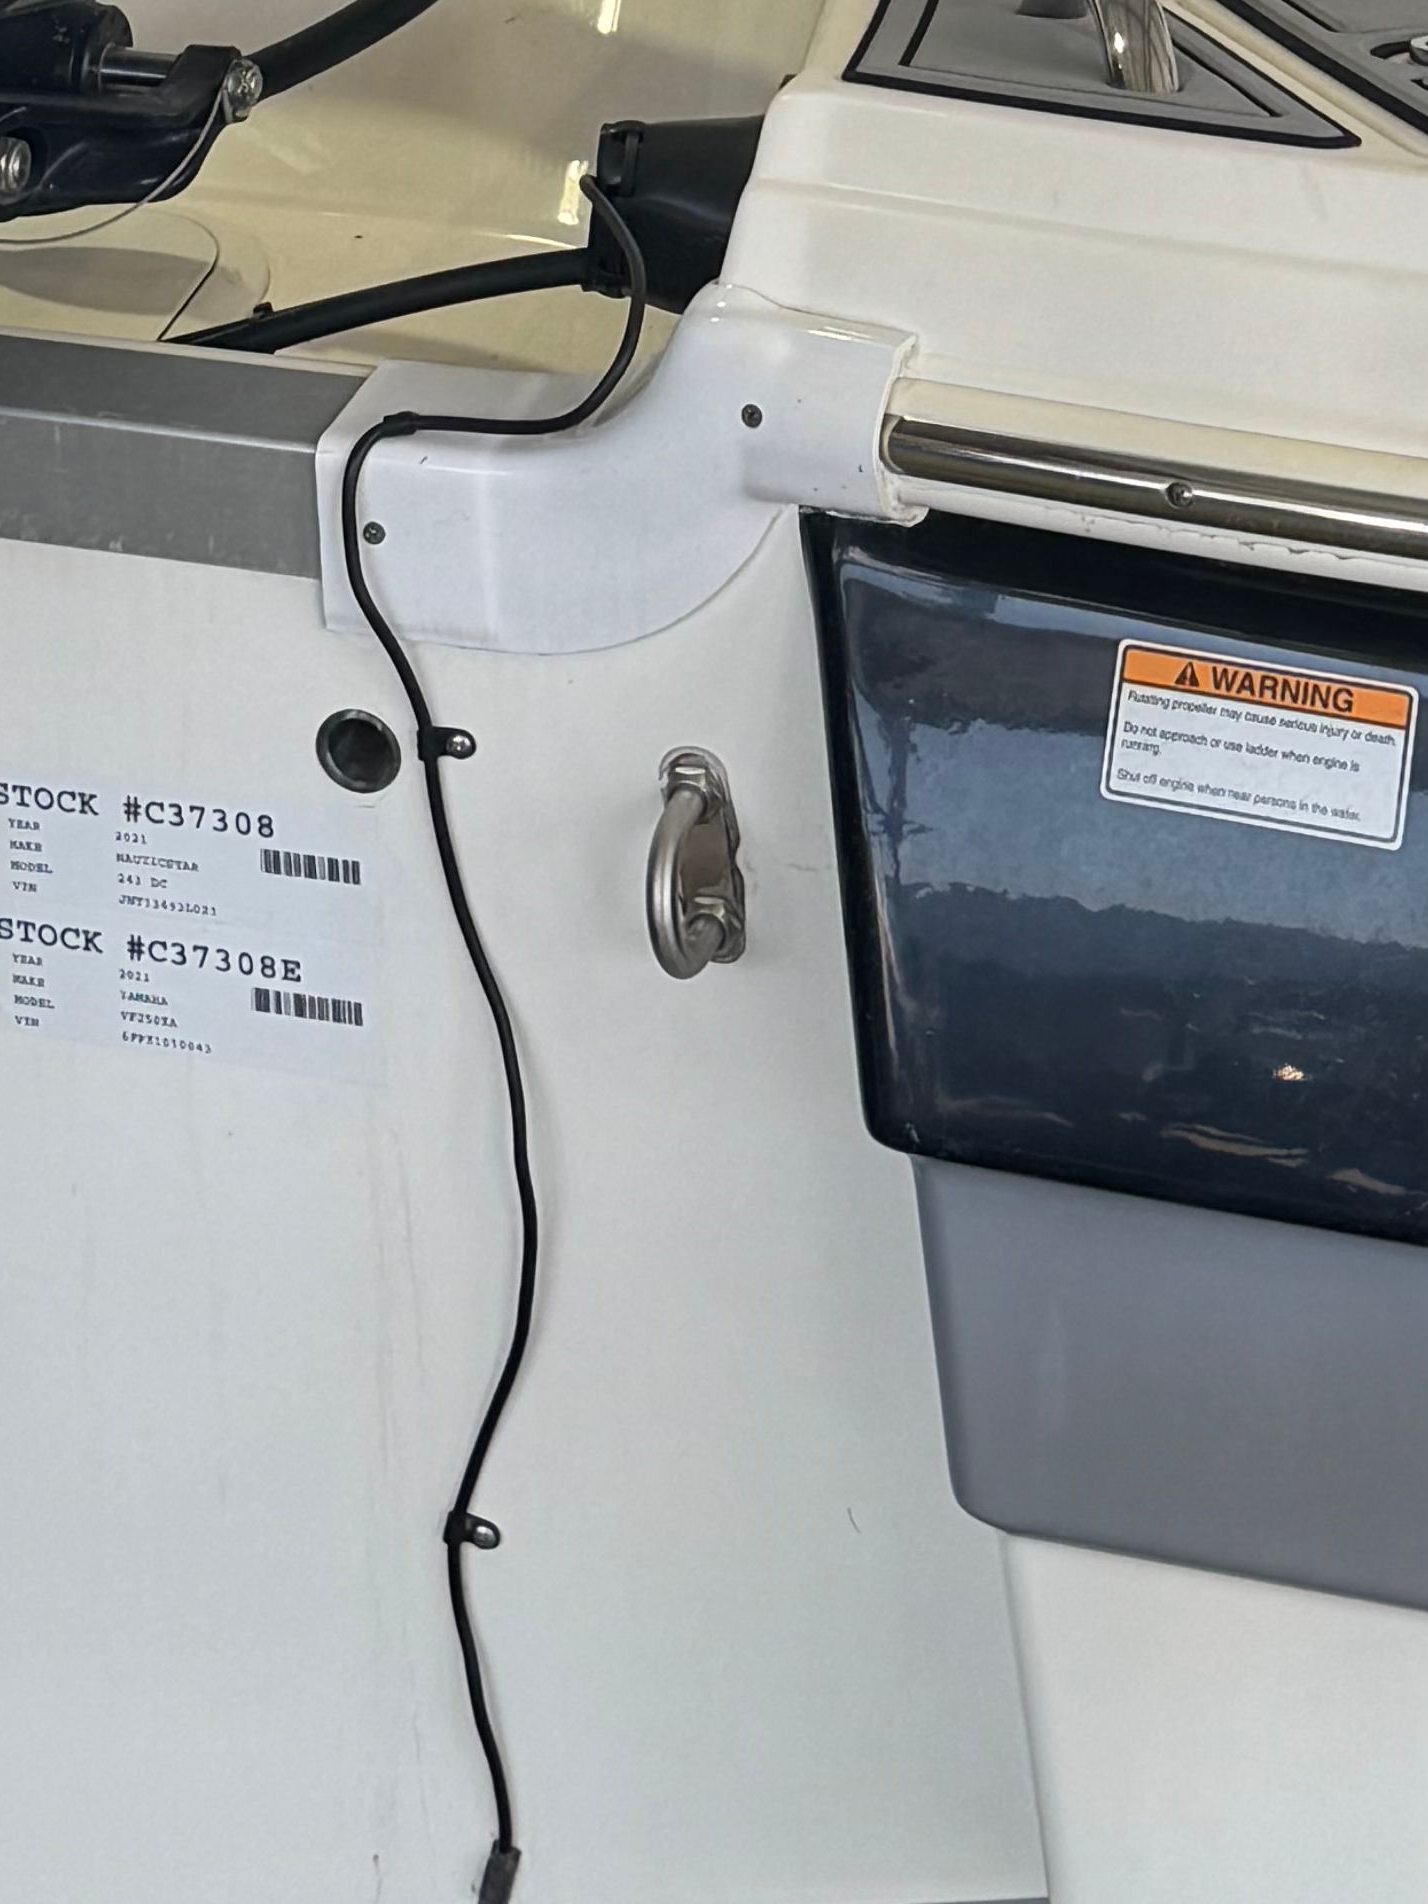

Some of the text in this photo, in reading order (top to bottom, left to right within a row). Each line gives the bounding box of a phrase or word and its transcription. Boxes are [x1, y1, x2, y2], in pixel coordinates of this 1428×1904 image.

[1211, 666, 1355, 713] WARNING
[1220, 707, 1242, 722] may
[1244, 711, 1277, 725] cause
[1279, 718, 1318, 732] serious
[1319, 723, 1349, 741] injury
[1351, 730, 1363, 740] or
[1123, 721, 1360, 772] Do not approach or use ladder when engine is
[1117, 768, 1141, 782] Shut
[1143, 772, 1157, 784] off
[1159, 777, 1194, 792] engine
[1197, 781, 1226, 798] when
[1227, 787, 1252, 803] near
[1253, 793, 1296, 810] persons
[1299, 799, 1309, 811] in
[1311, 803, 1328, 816] the
[8, 818, 147, 845] YEAR 2021
[122, 795, 276, 839] #C37308
[9, 840, 42, 853] MAKE
[10, 861, 53, 874] MODEL
[150, 877, 168, 889] DC
[12, 880, 37, 893] VIN
[12, 953, 150, 983] YEAR 2021
[127, 934, 301, 983] #C37308E
[12, 973, 168, 1006] MAKE YAMAHA
[13, 994, 56, 1009] MODEL
[14, 1014, 40, 1028] VIN
